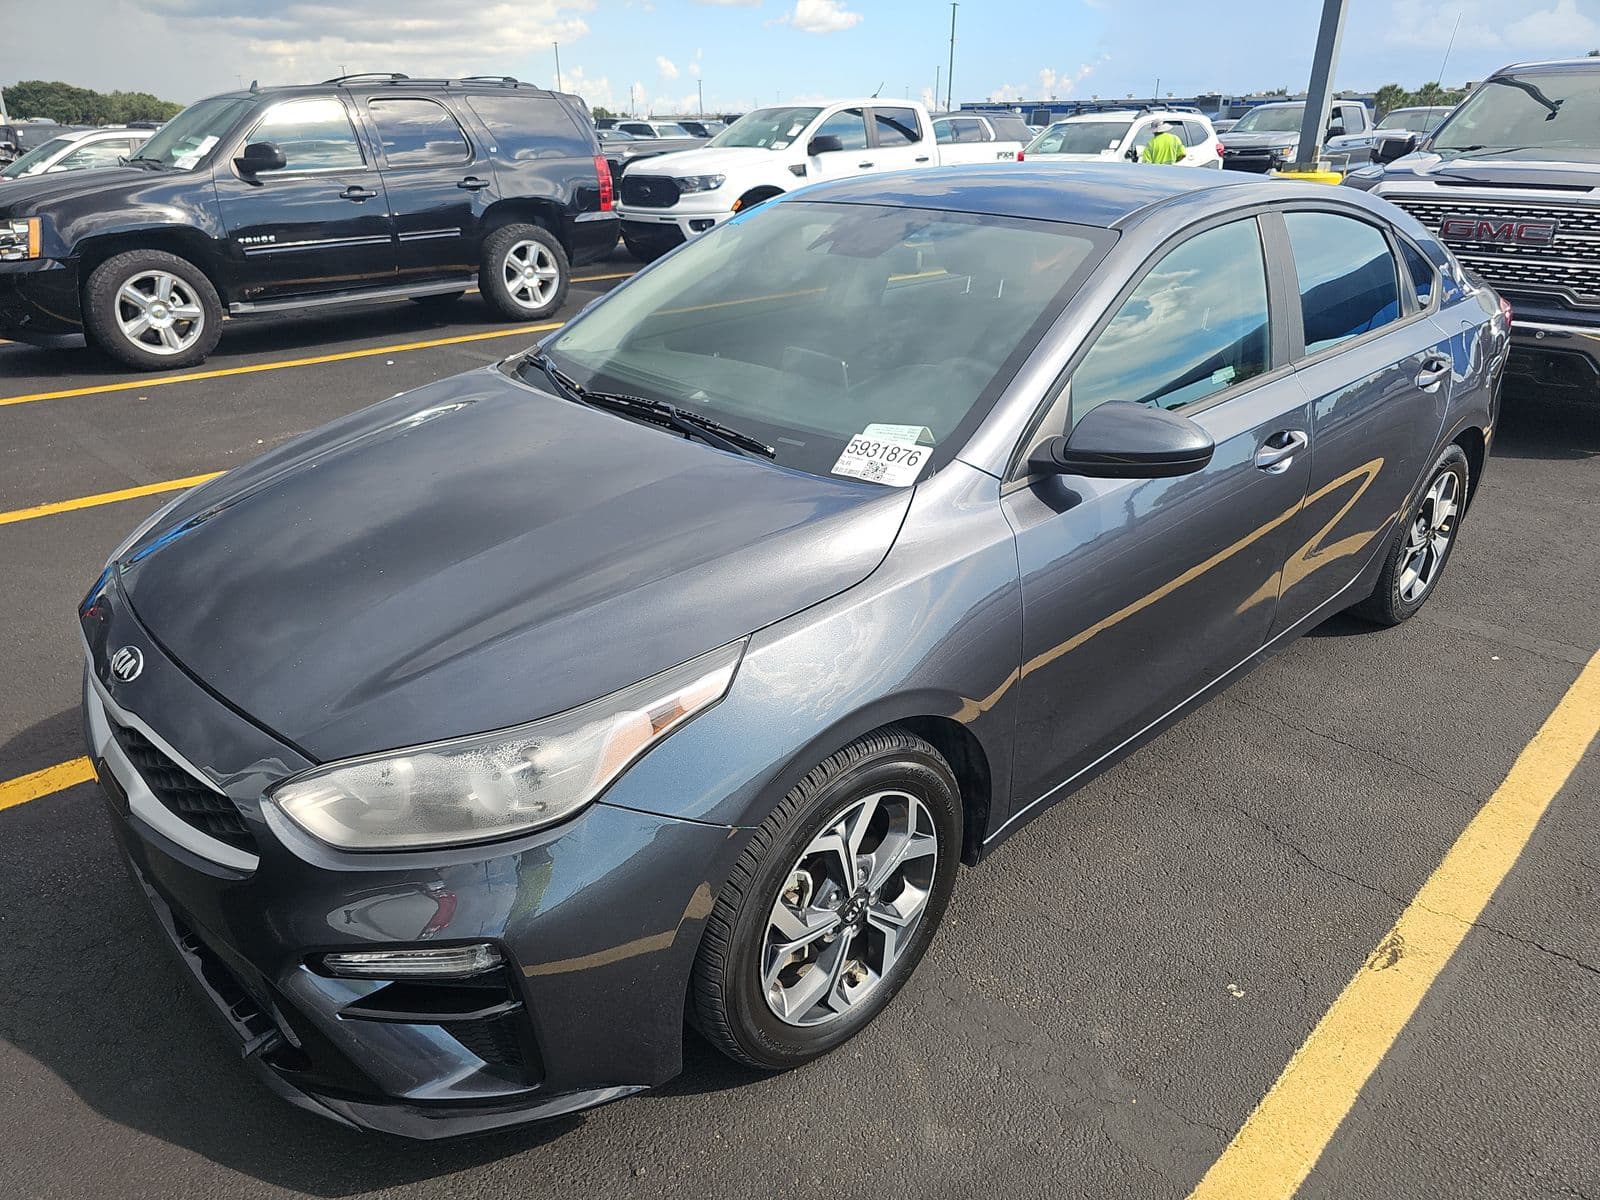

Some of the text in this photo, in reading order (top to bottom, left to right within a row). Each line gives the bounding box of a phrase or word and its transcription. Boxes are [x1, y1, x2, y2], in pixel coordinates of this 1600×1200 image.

[238, 235, 276, 244] TAHOE
[1442, 219, 1555, 243] GMC
[846, 439, 922, 467] 5931876
